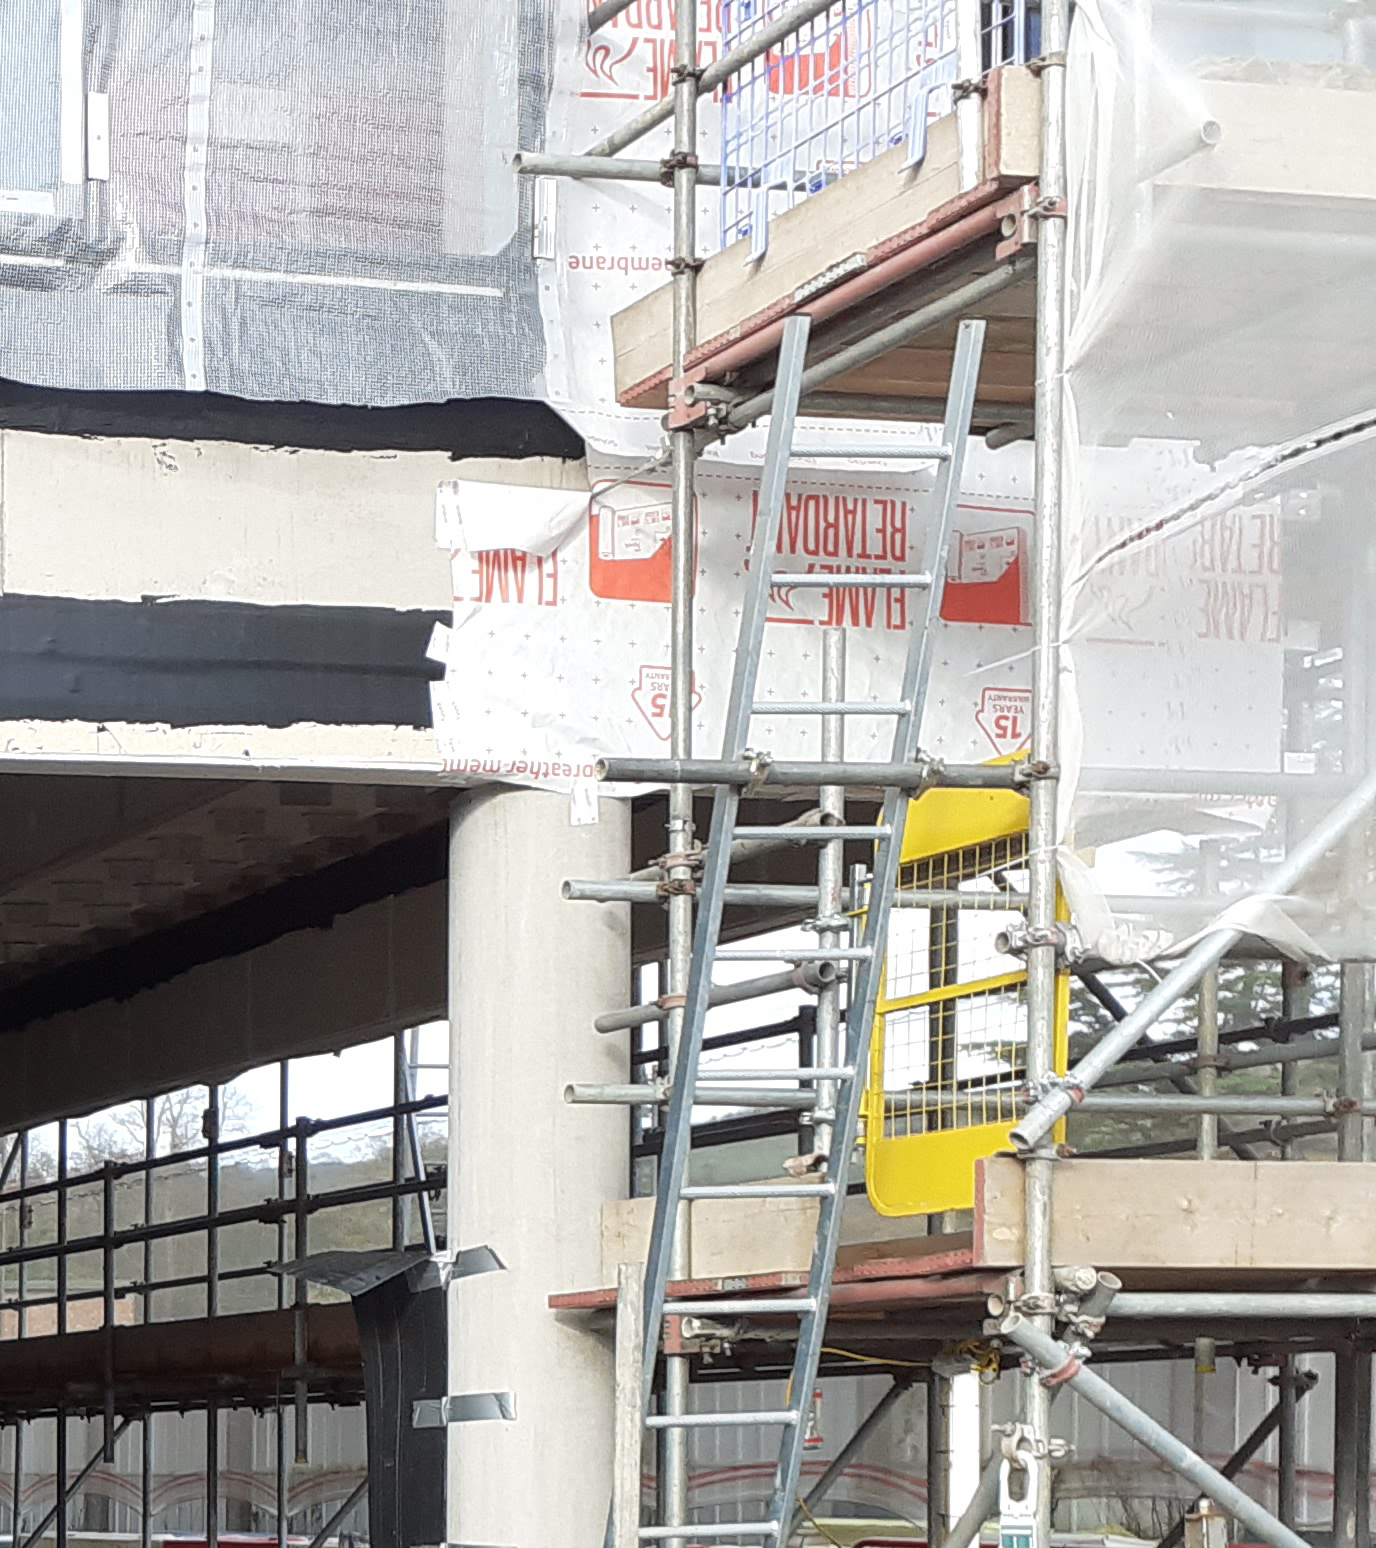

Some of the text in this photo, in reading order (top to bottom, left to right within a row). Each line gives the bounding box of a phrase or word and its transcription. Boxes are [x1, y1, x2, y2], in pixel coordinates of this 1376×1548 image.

[818, 563, 906, 630] FLAME
[993, 703, 1025, 715] YEARS
[994, 715, 1021, 739] 15
